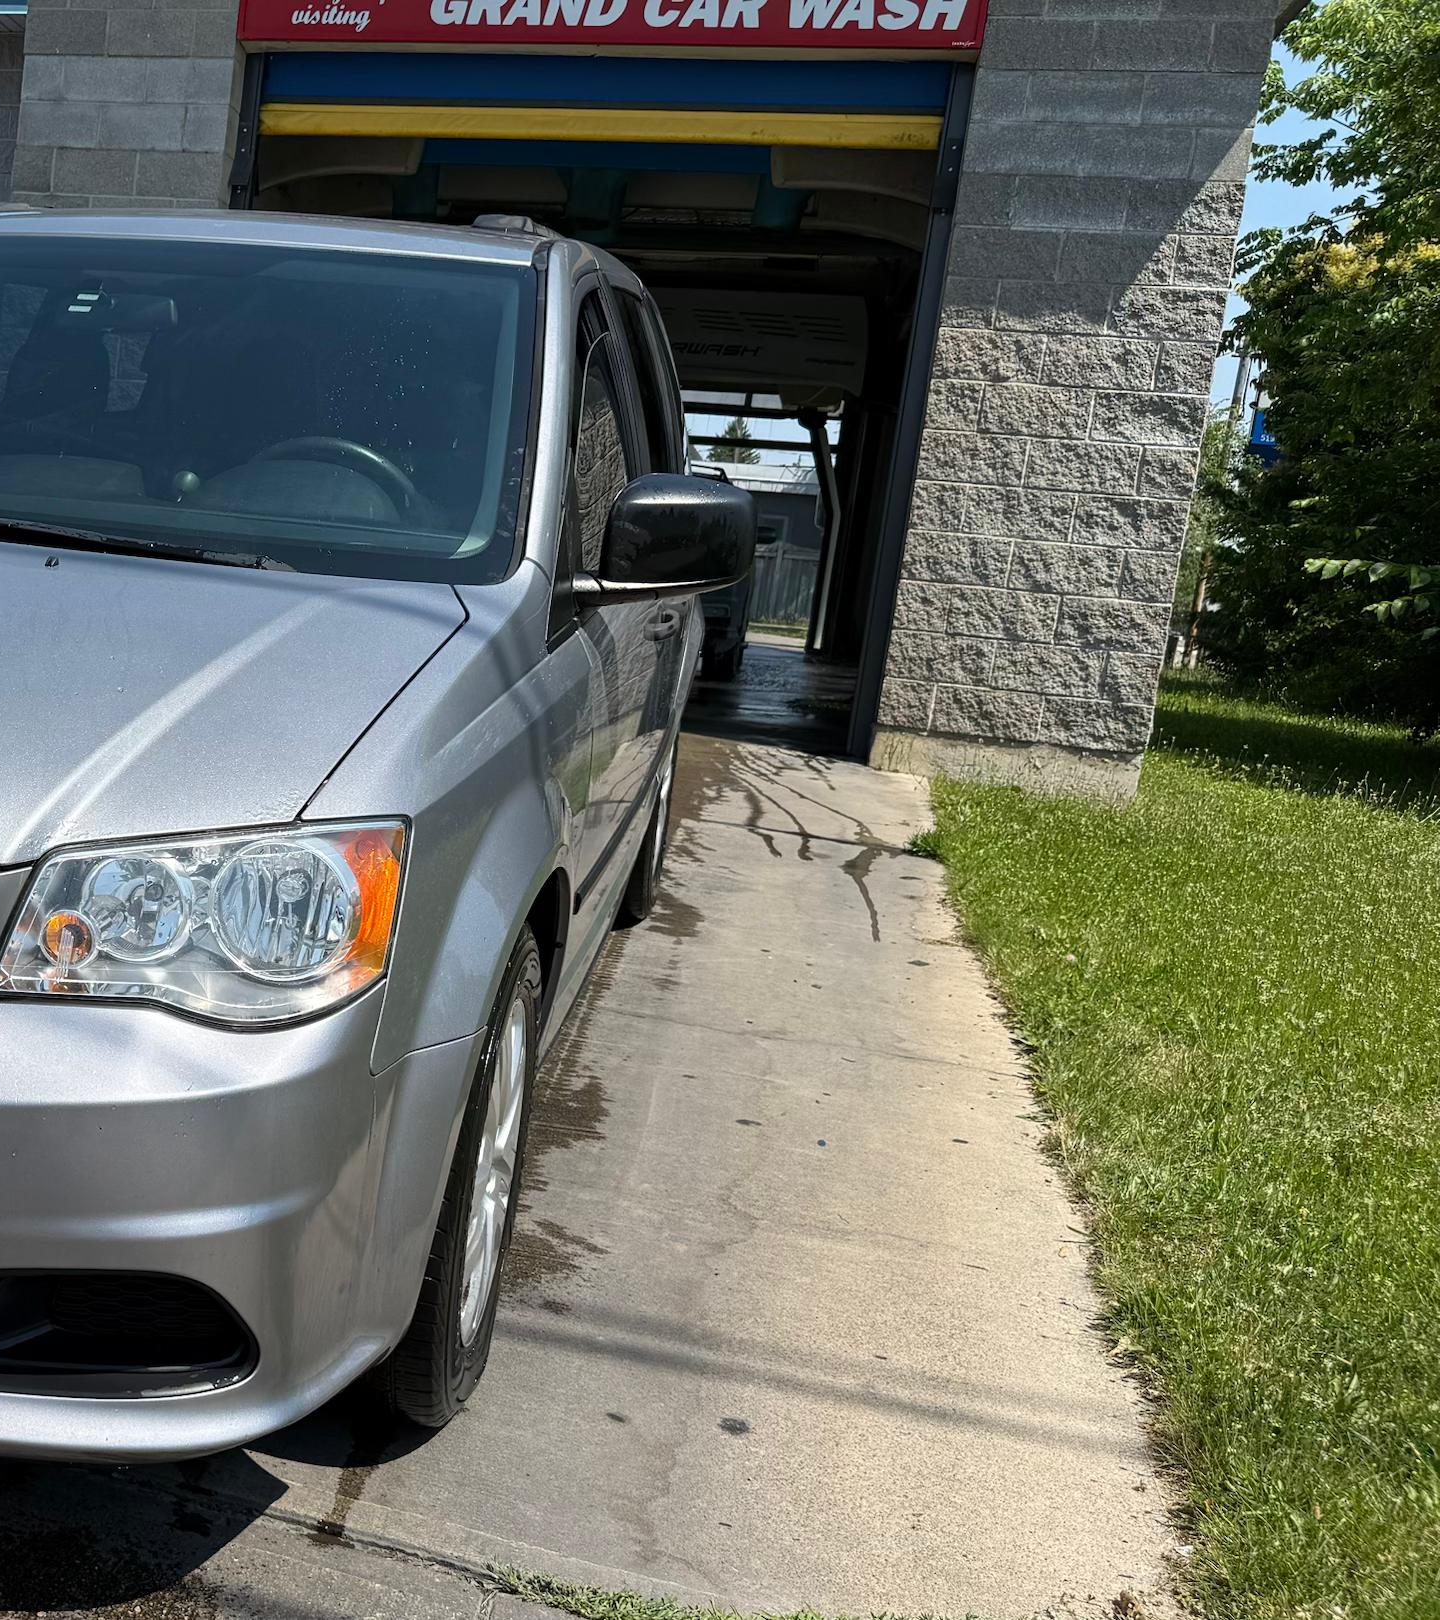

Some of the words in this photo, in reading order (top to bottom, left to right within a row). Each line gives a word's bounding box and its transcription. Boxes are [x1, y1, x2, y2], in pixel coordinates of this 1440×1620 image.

[291, 4, 371, 33] visiting
[428, 0, 629, 27] GRAND
[643, 0, 763, 29] CAR
[788, 0, 968, 31] WASH
[670, 341, 761, 357] RWASH
